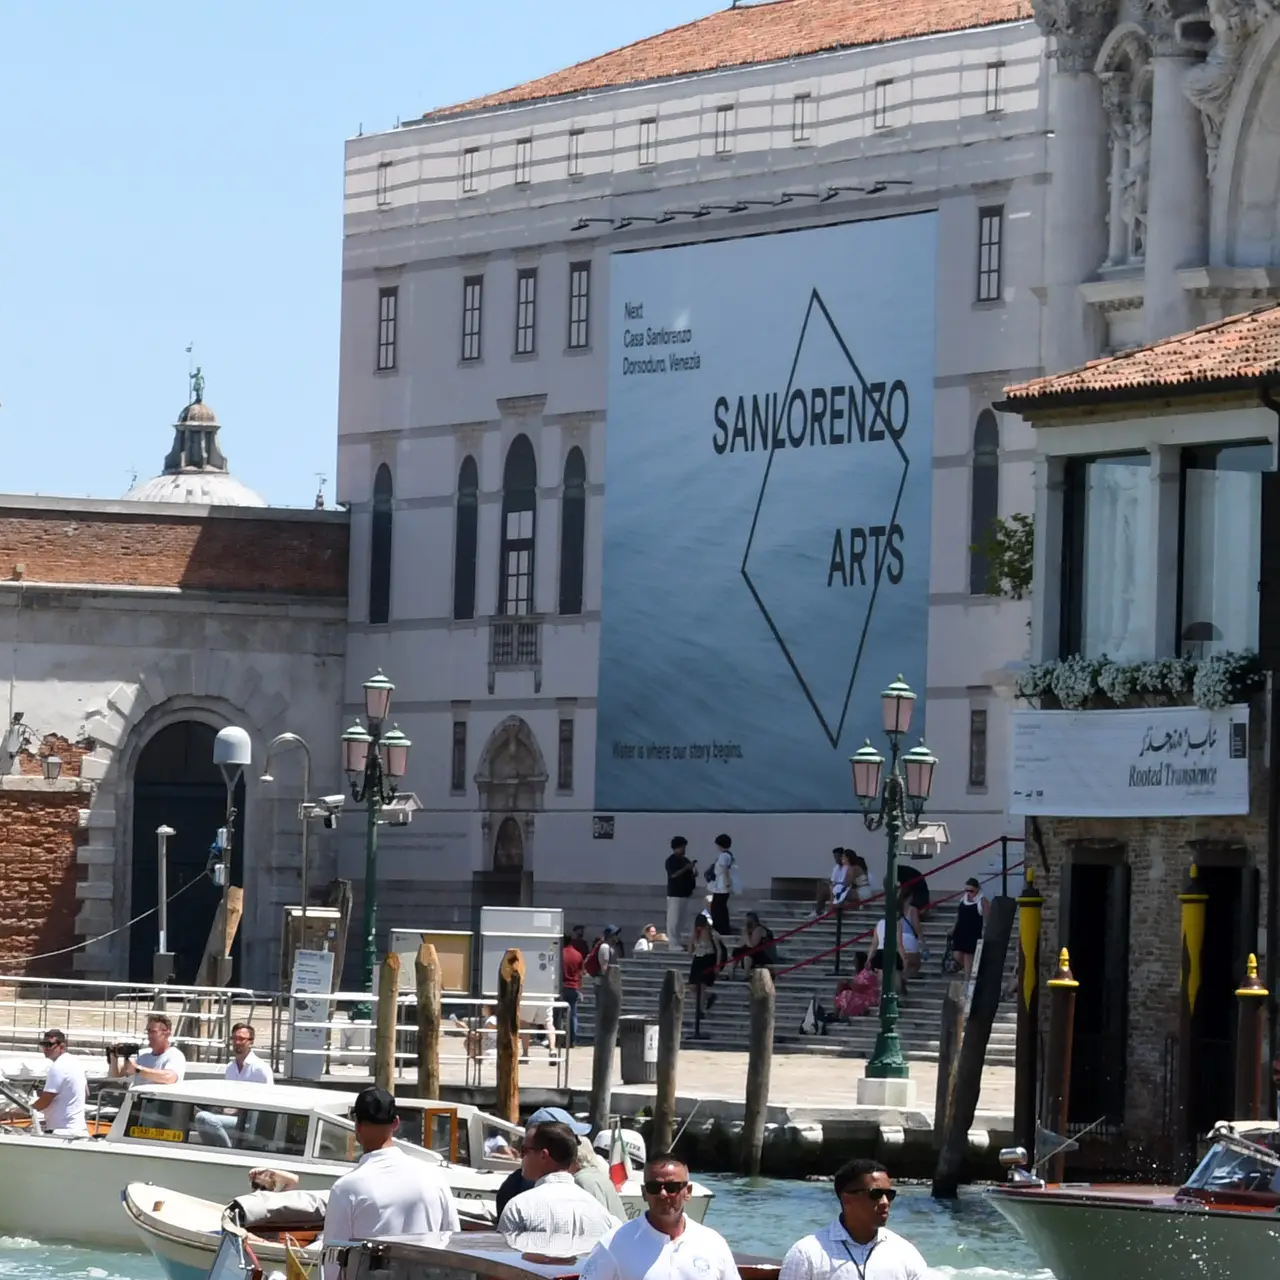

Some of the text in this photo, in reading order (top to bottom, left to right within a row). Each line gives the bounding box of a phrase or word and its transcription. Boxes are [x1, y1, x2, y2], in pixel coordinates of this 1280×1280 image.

[624, 301, 644, 321] Next
[623, 326, 692, 348] Casa Sanlorenzo
[668, 351, 701, 372] Venezia
[712, 379, 910, 455] SANLORENZO
[826, 523, 905, 588] ARTS
[1128, 760, 1218, 788] Rooted Transience
